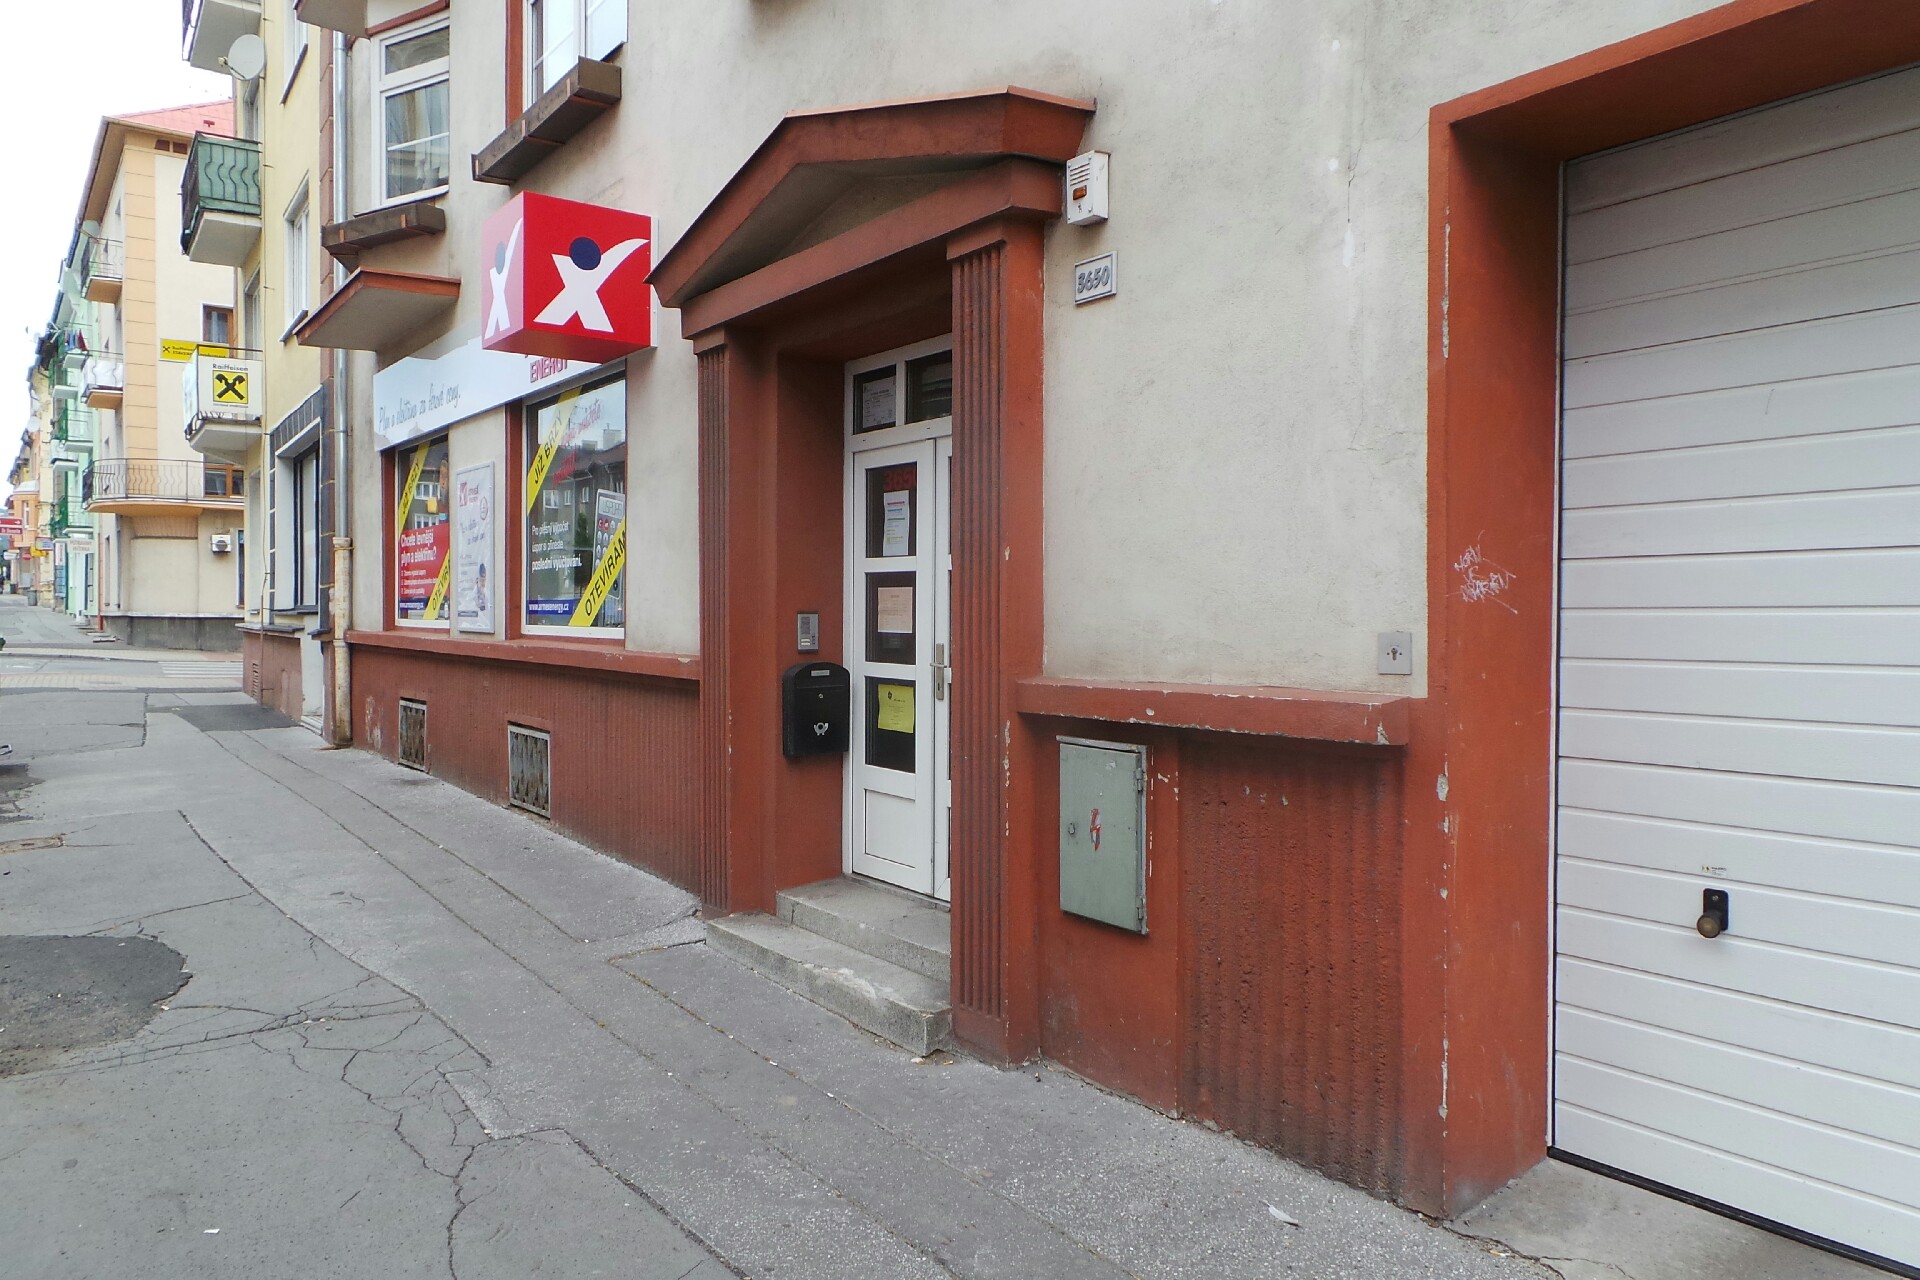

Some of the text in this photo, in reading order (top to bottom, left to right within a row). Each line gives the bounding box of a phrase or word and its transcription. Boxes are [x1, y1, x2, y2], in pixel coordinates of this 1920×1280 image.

[1077, 265, 1110, 293] 3650
[213, 363, 249, 373] Raiffeisen
[544, 410, 563, 459] BRZY
[401, 532, 415, 548] Chcete
[401, 550, 410, 567] plyn
